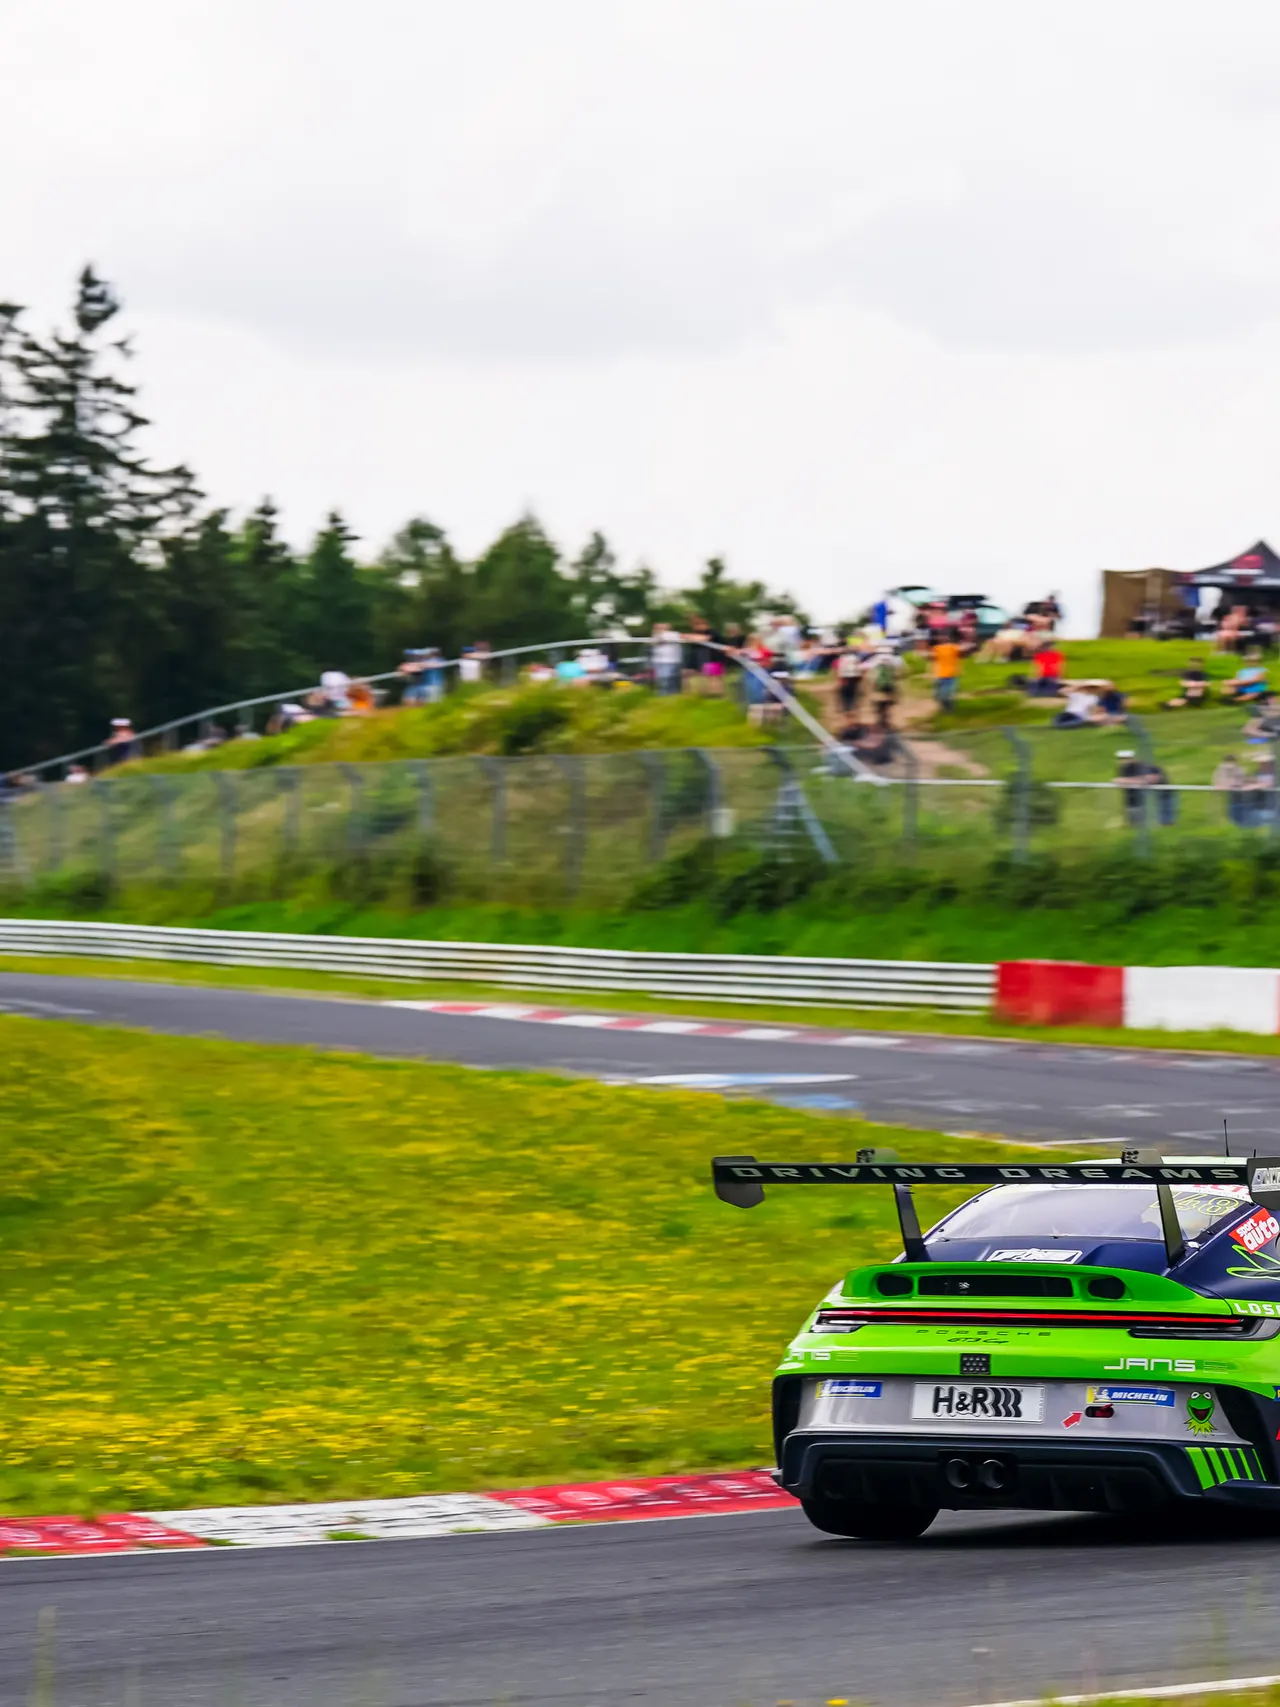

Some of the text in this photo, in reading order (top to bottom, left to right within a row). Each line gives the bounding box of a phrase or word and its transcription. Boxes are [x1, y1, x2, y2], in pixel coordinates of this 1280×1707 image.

[731, 1167, 1240, 1179] DRIVING DREAMS
[1236, 1218, 1258, 1237] sport
[1243, 1216, 1280, 1250] auto
[1104, 1357, 1196, 1372] JANS
[1110, 1391, 1168, 1401] MICHELIN
